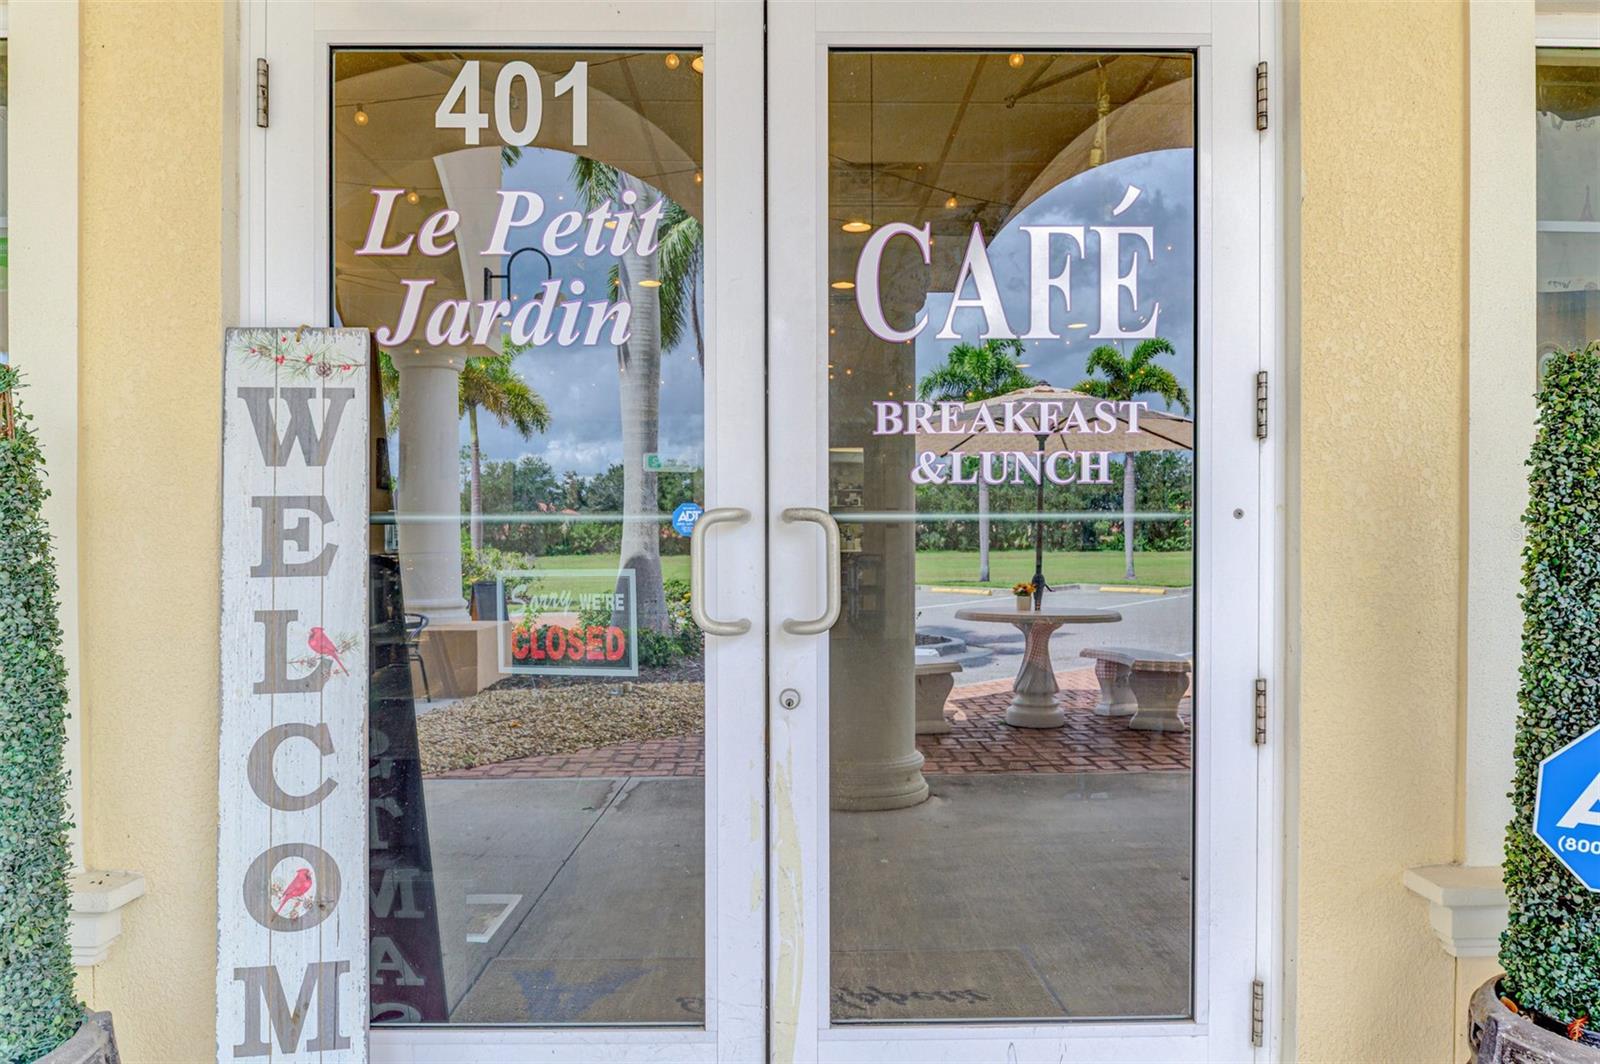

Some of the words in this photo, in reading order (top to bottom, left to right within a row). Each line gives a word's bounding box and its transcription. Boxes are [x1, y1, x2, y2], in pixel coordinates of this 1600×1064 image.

[435, 60, 589, 147] 401
[354, 188, 461, 257] Le
[480, 188, 664, 258] Petit
[855, 185, 1161, 344] CAFÉ
[376, 278, 633, 348] Jardin
[872, 400, 1150, 437] BREAKFAST
[909, 450, 1115, 487] &LUNCH
[677, 510, 703, 522] ADT
[507, 584, 573, 616] Sorry
[579, 593, 625, 611] WE'RE
[511, 624, 626, 661] CLOSED
[233, 387, 355, 1058] WELCOM
